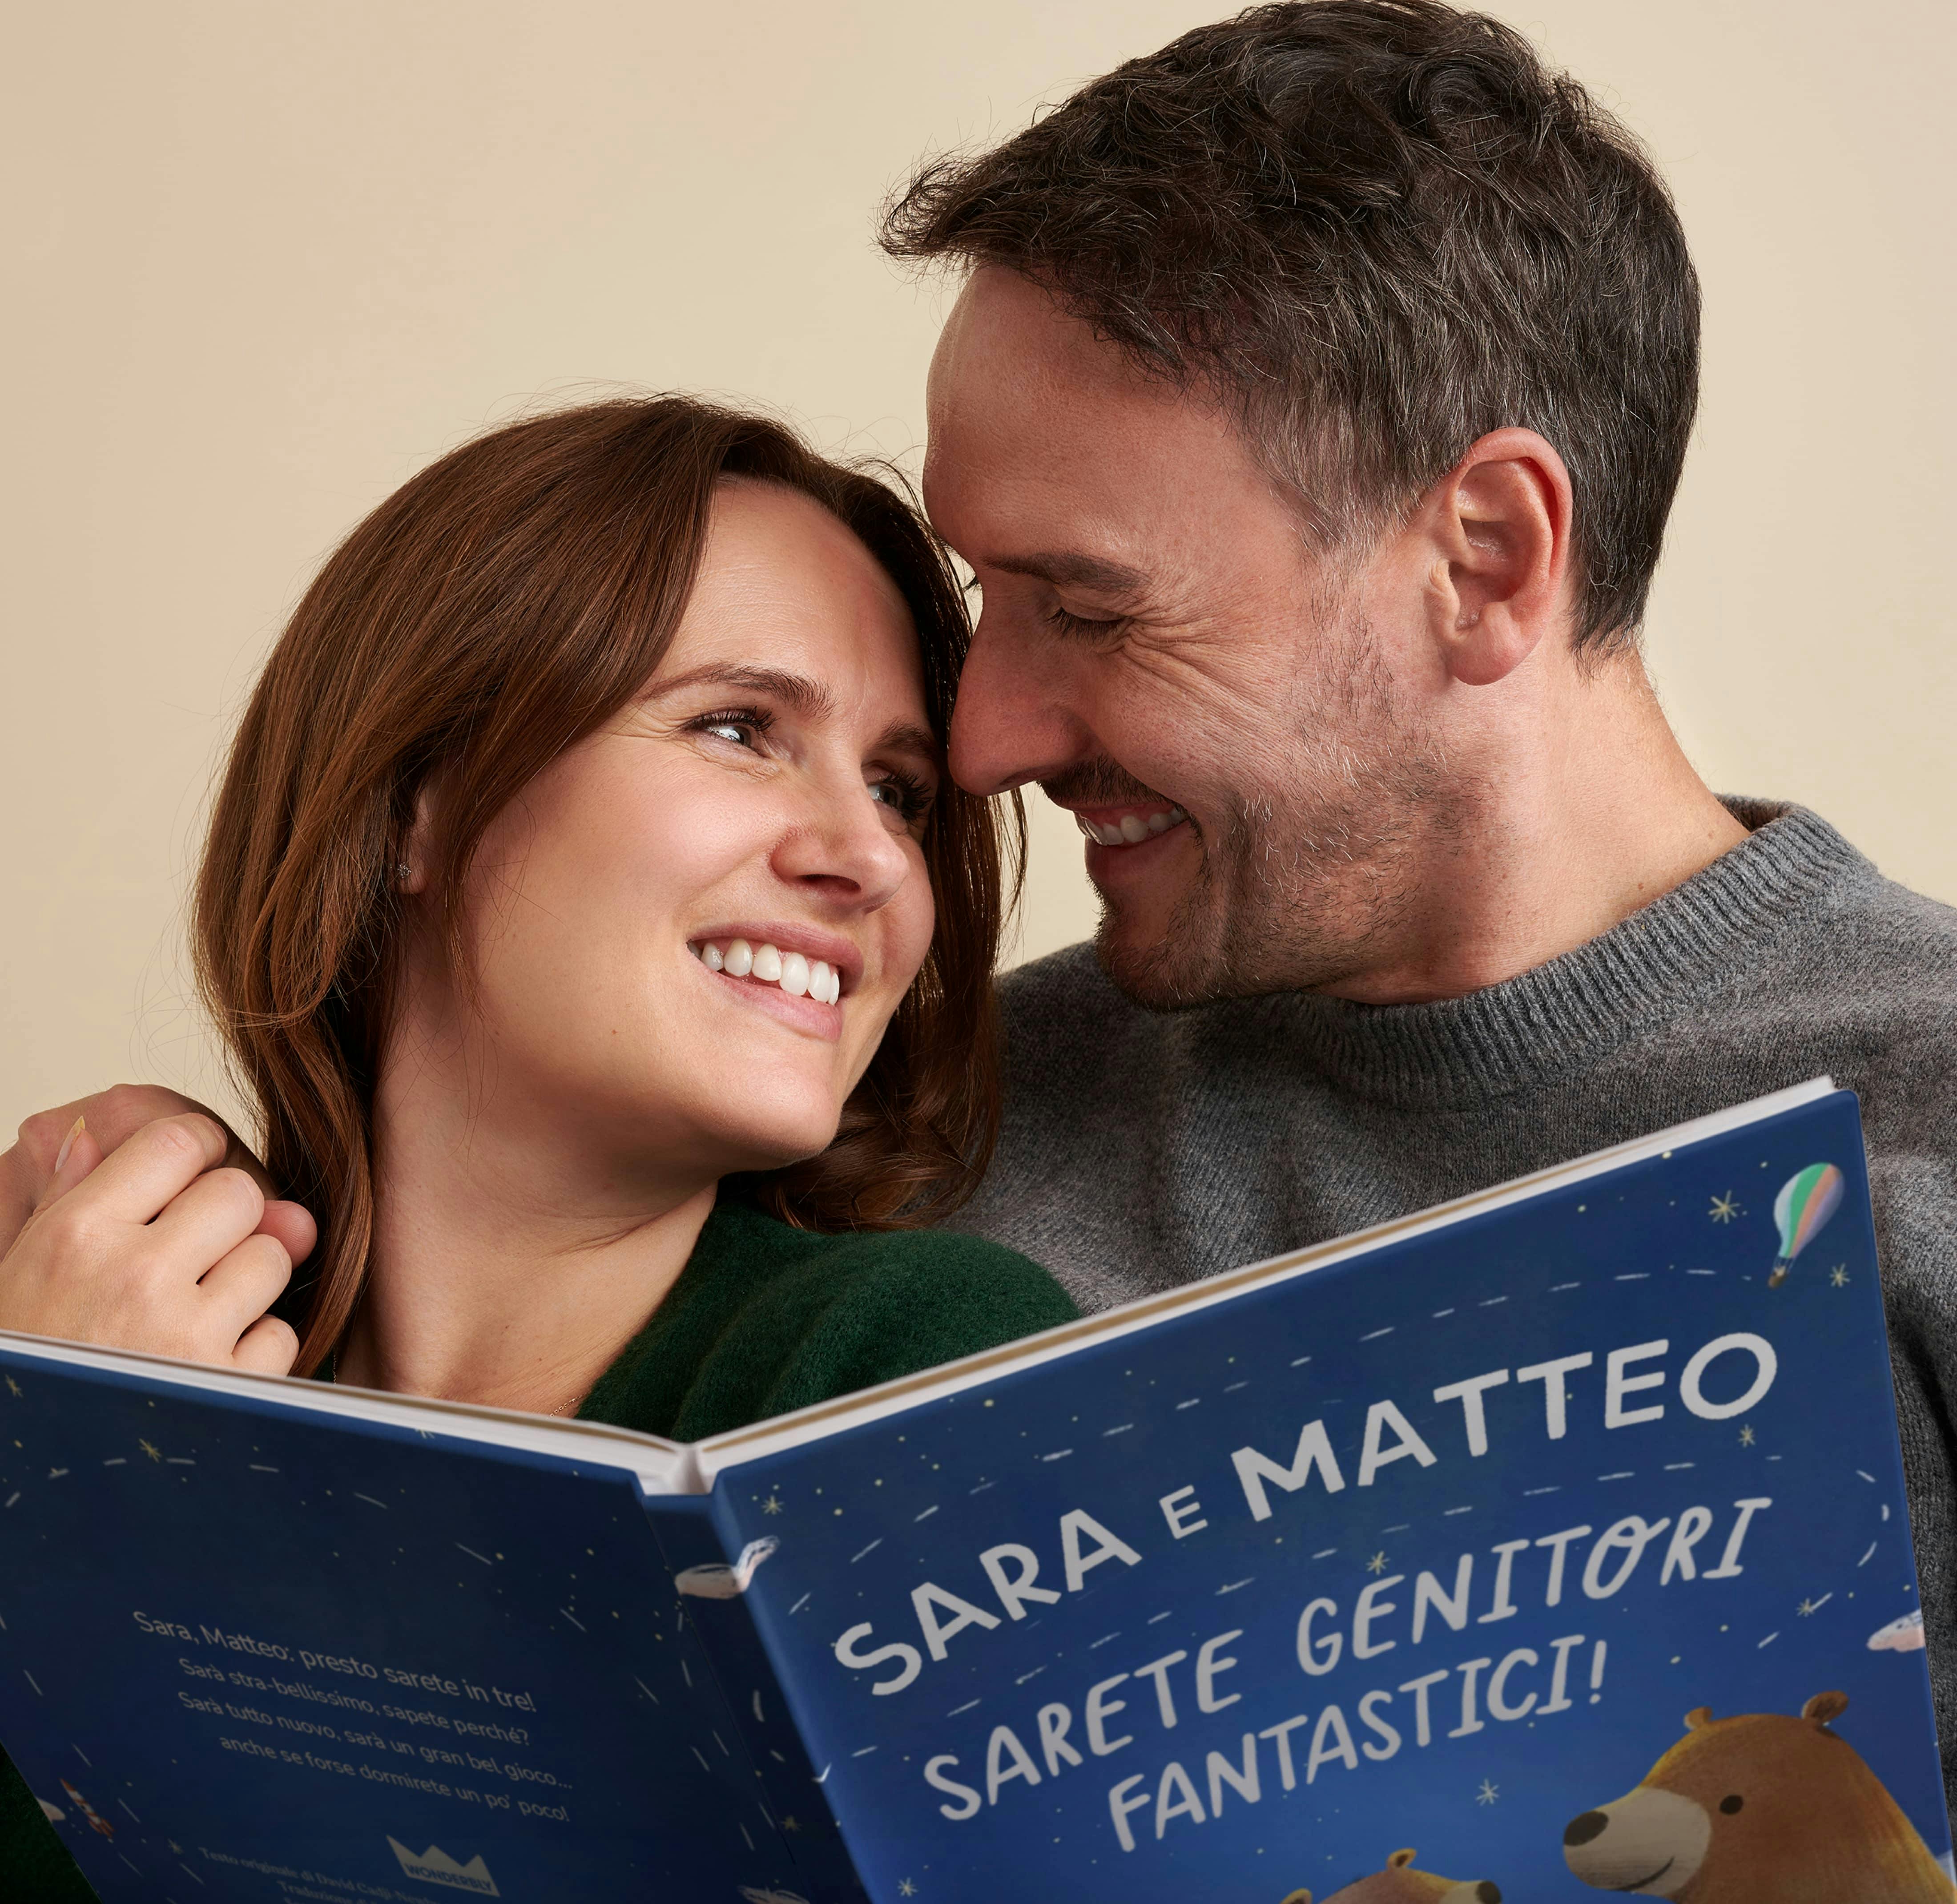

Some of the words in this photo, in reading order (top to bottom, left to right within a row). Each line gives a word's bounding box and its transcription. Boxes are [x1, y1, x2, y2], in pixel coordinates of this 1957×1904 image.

[834, 1509, 1143, 1696] SARA
[1159, 1485, 1208, 1539] E
[1230, 1332, 1778, 1522] MATTEO
[133, 1611, 199, 1645] Sara,
[200, 1624, 295, 1662] Matteo:
[299, 1649, 379, 1679] presto
[383, 1667, 461, 1697] sarete
[462, 1679, 490, 1702] in
[492, 1686, 537, 1713] tre!
[179, 1658, 225, 1682] Sarà
[229, 1671, 381, 1717] stra-bellissimo,
[382, 1704, 451, 1729] sapete
[453, 1718, 530, 1747] perché?
[924, 1629, 1243, 1820] SARETE
[1297, 1497, 1772, 1676] GENITORI
[178, 1691, 224, 1715] Sarà
[225, 1702, 274, 1726] tutto
[277, 1715, 342, 1743] nuovo,
[343, 1730, 387, 1750] sarà
[390, 1739, 415, 1756] un
[419, 1746, 465, 1766] gran
[466, 1752, 502, 1775] bel
[504, 1761, 573, 1789] gioco...
[219, 1736, 278, 1760] anche
[280, 1749, 304, 1765] se
[305, 1751, 356, 1776] forse
[359, 1764, 452, 1797] dormirete
[455, 1787, 481, 1803] un
[484, 1793, 511, 1809] po'
[517, 1800, 571, 1822] poco!
[1109, 1634, 1608, 1852] FANTASTICI!
[198, 1846, 239, 1865] Testo
[240, 1858, 299, 1879] originale
[301, 1870, 315, 1883] di
[314, 1872, 355, 1892] David
[404, 1864, 492, 1892] WONDERBLY
